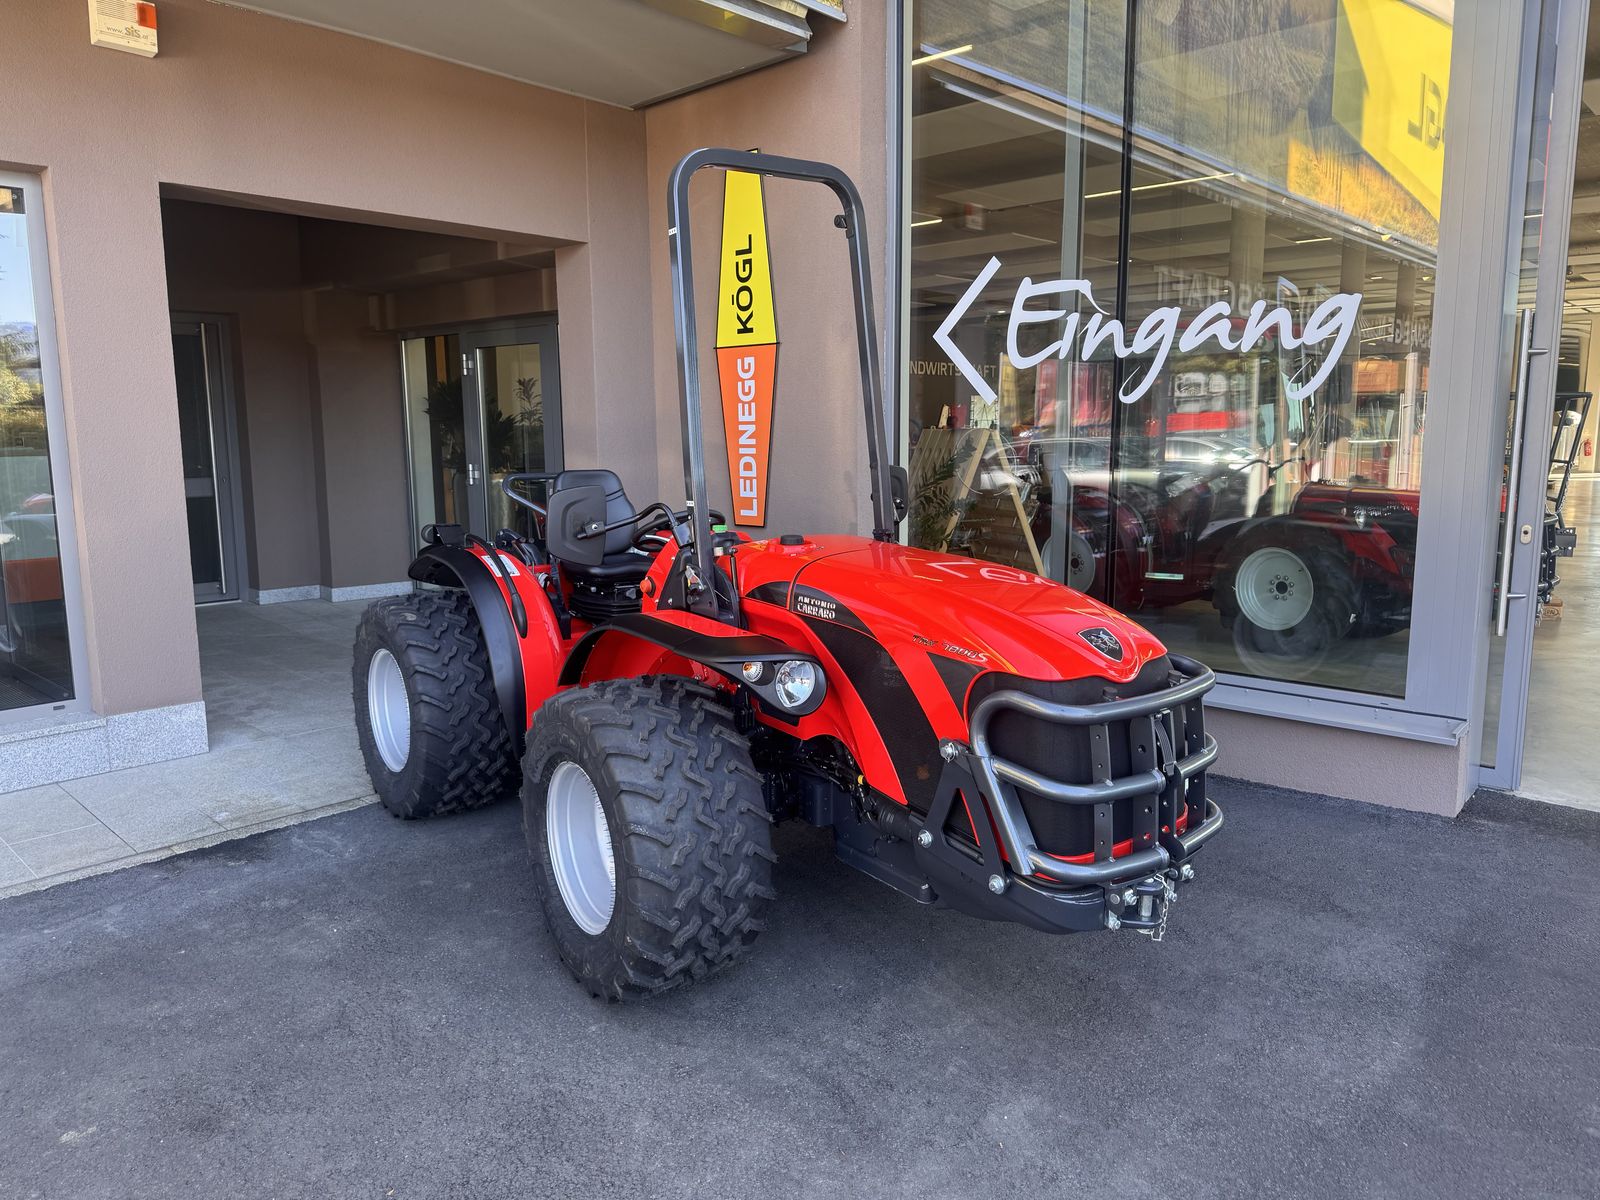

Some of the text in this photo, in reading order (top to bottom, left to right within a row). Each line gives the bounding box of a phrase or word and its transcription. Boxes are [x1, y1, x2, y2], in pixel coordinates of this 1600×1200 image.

[1006, 276, 1363, 405] Eingang
[737, 356, 757, 517] LEDINEGG
[797, 603, 836, 619] CARRARO
[798, 596, 836, 609] ANTONIO
